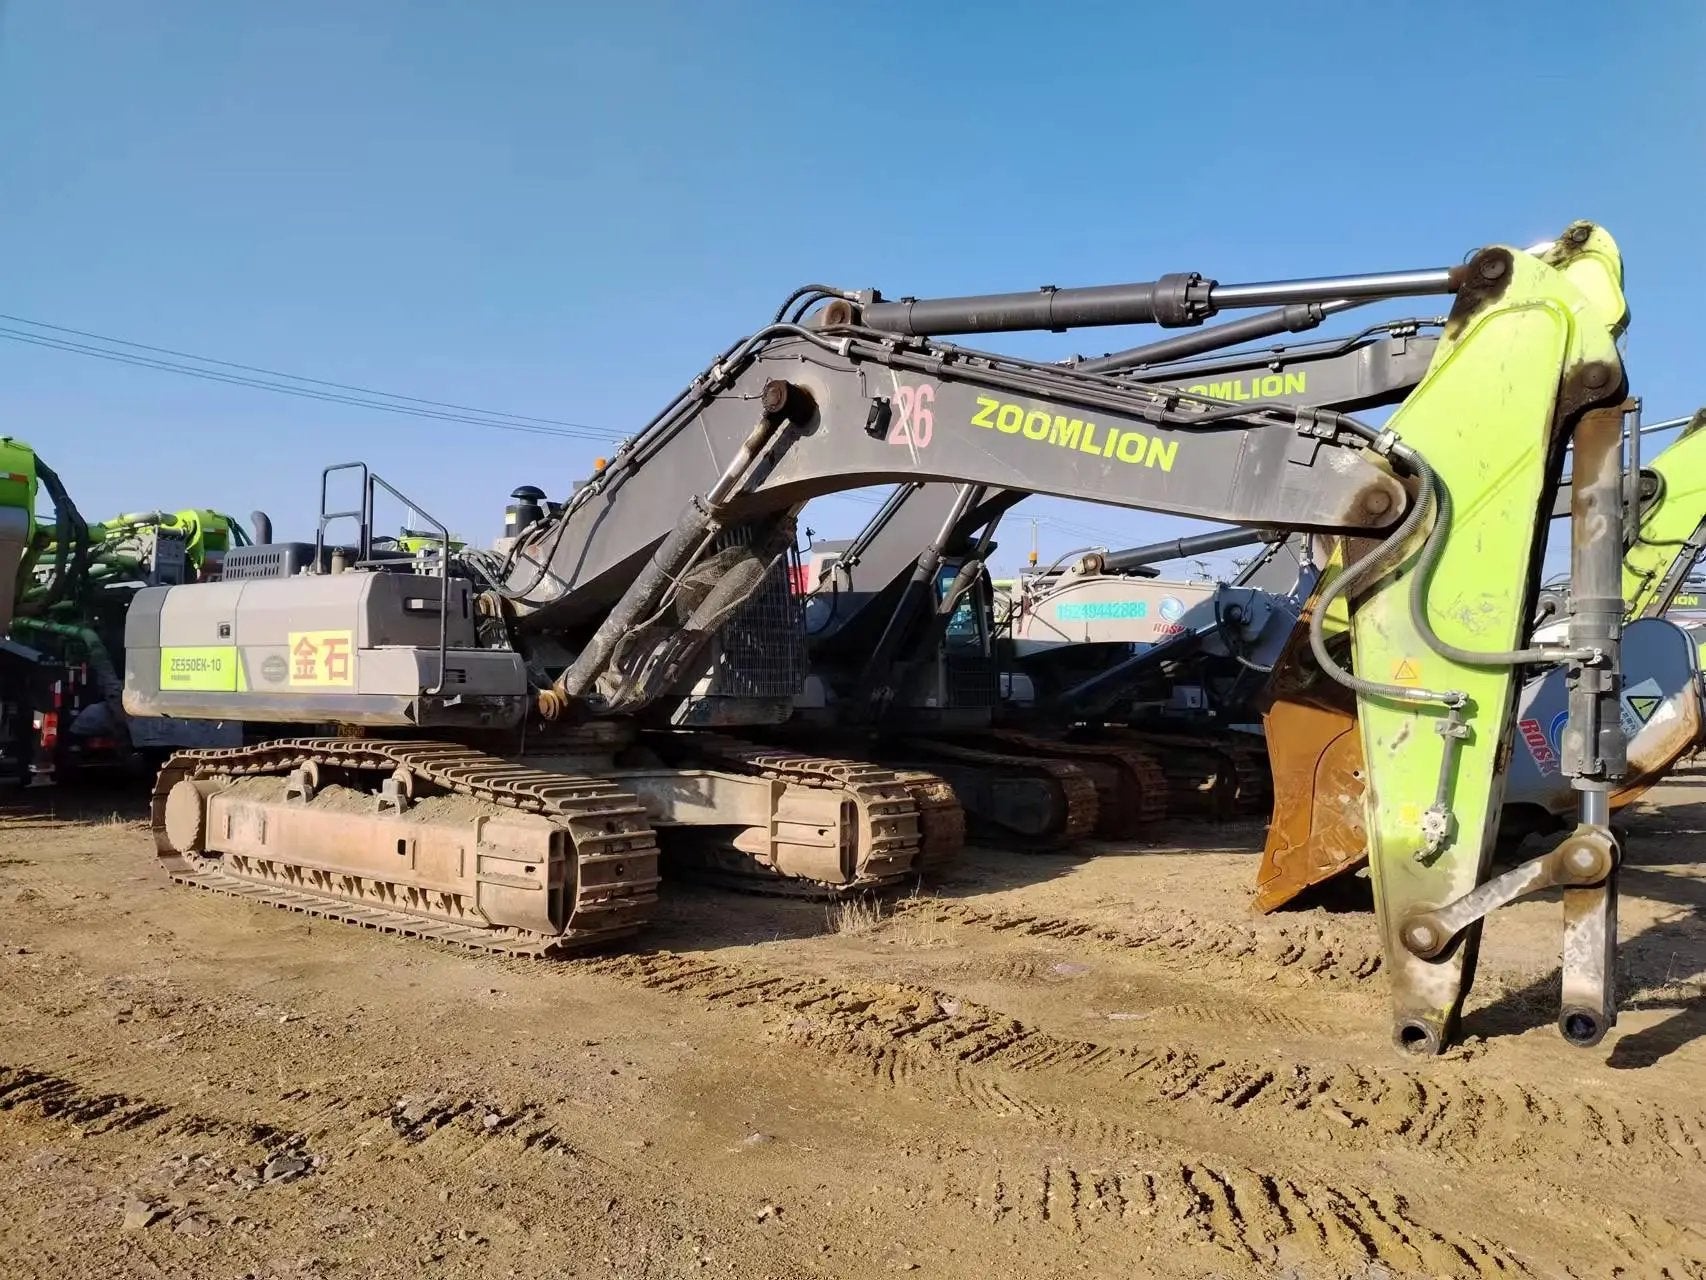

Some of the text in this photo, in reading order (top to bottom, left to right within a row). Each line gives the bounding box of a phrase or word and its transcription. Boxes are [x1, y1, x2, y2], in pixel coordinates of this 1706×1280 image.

[1181, 372, 1306, 400] OMLION
[889, 384, 934, 448] 26
[971, 396, 1179, 472] ZOOMLION
[170, 658, 221, 671] ZE550EK-10
[293, 636, 350, 681] 金石
